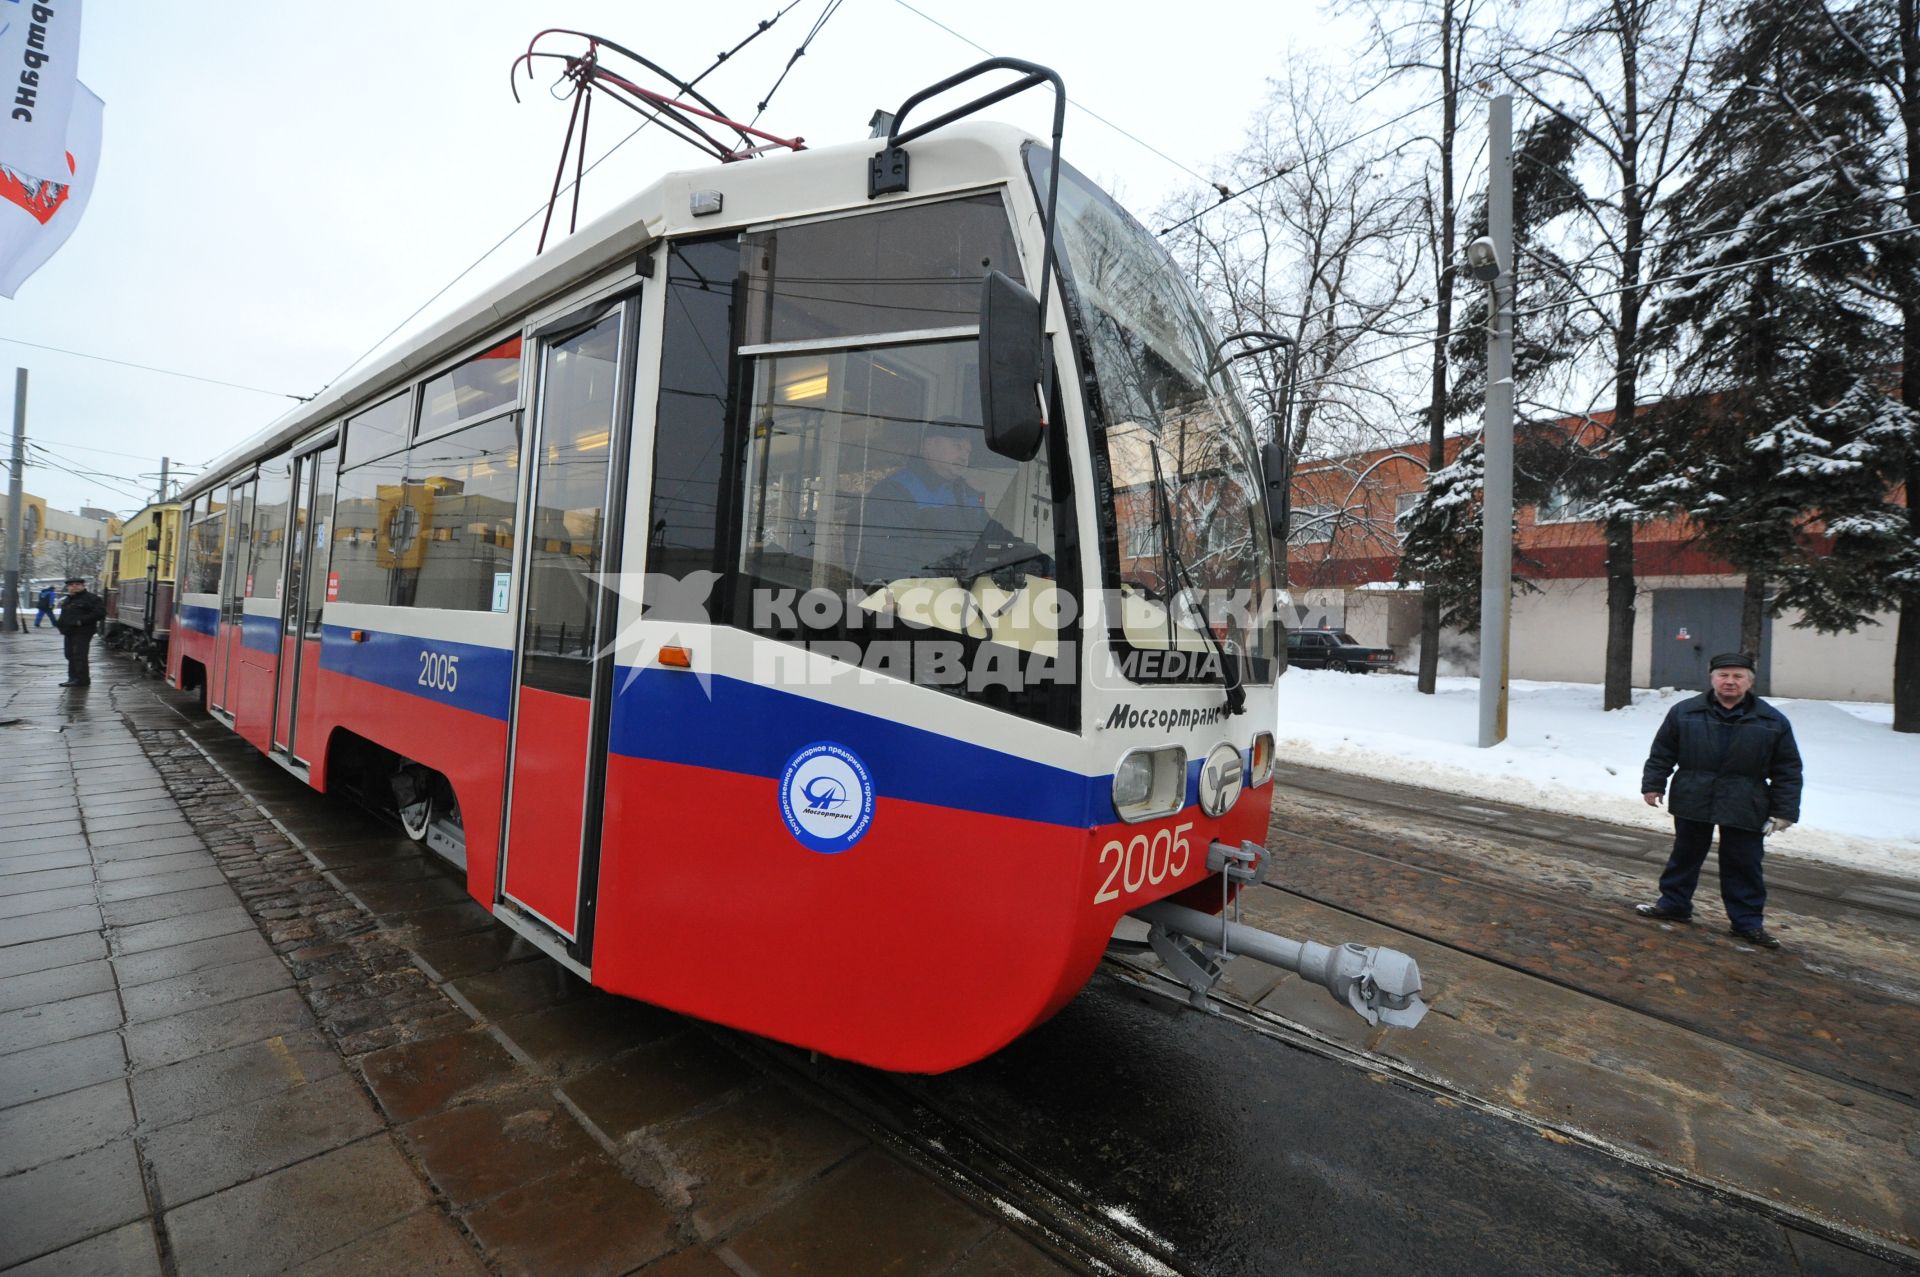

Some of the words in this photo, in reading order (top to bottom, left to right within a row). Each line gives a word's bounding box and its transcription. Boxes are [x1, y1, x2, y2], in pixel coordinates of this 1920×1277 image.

[418, 650, 459, 693] 2005
[1105, 704, 1221, 733] Мосгортранс
[802, 808, 853, 820] Мосгортранс
[847, 814, 870, 842] Москвы
[1093, 822, 1194, 905] 2005
